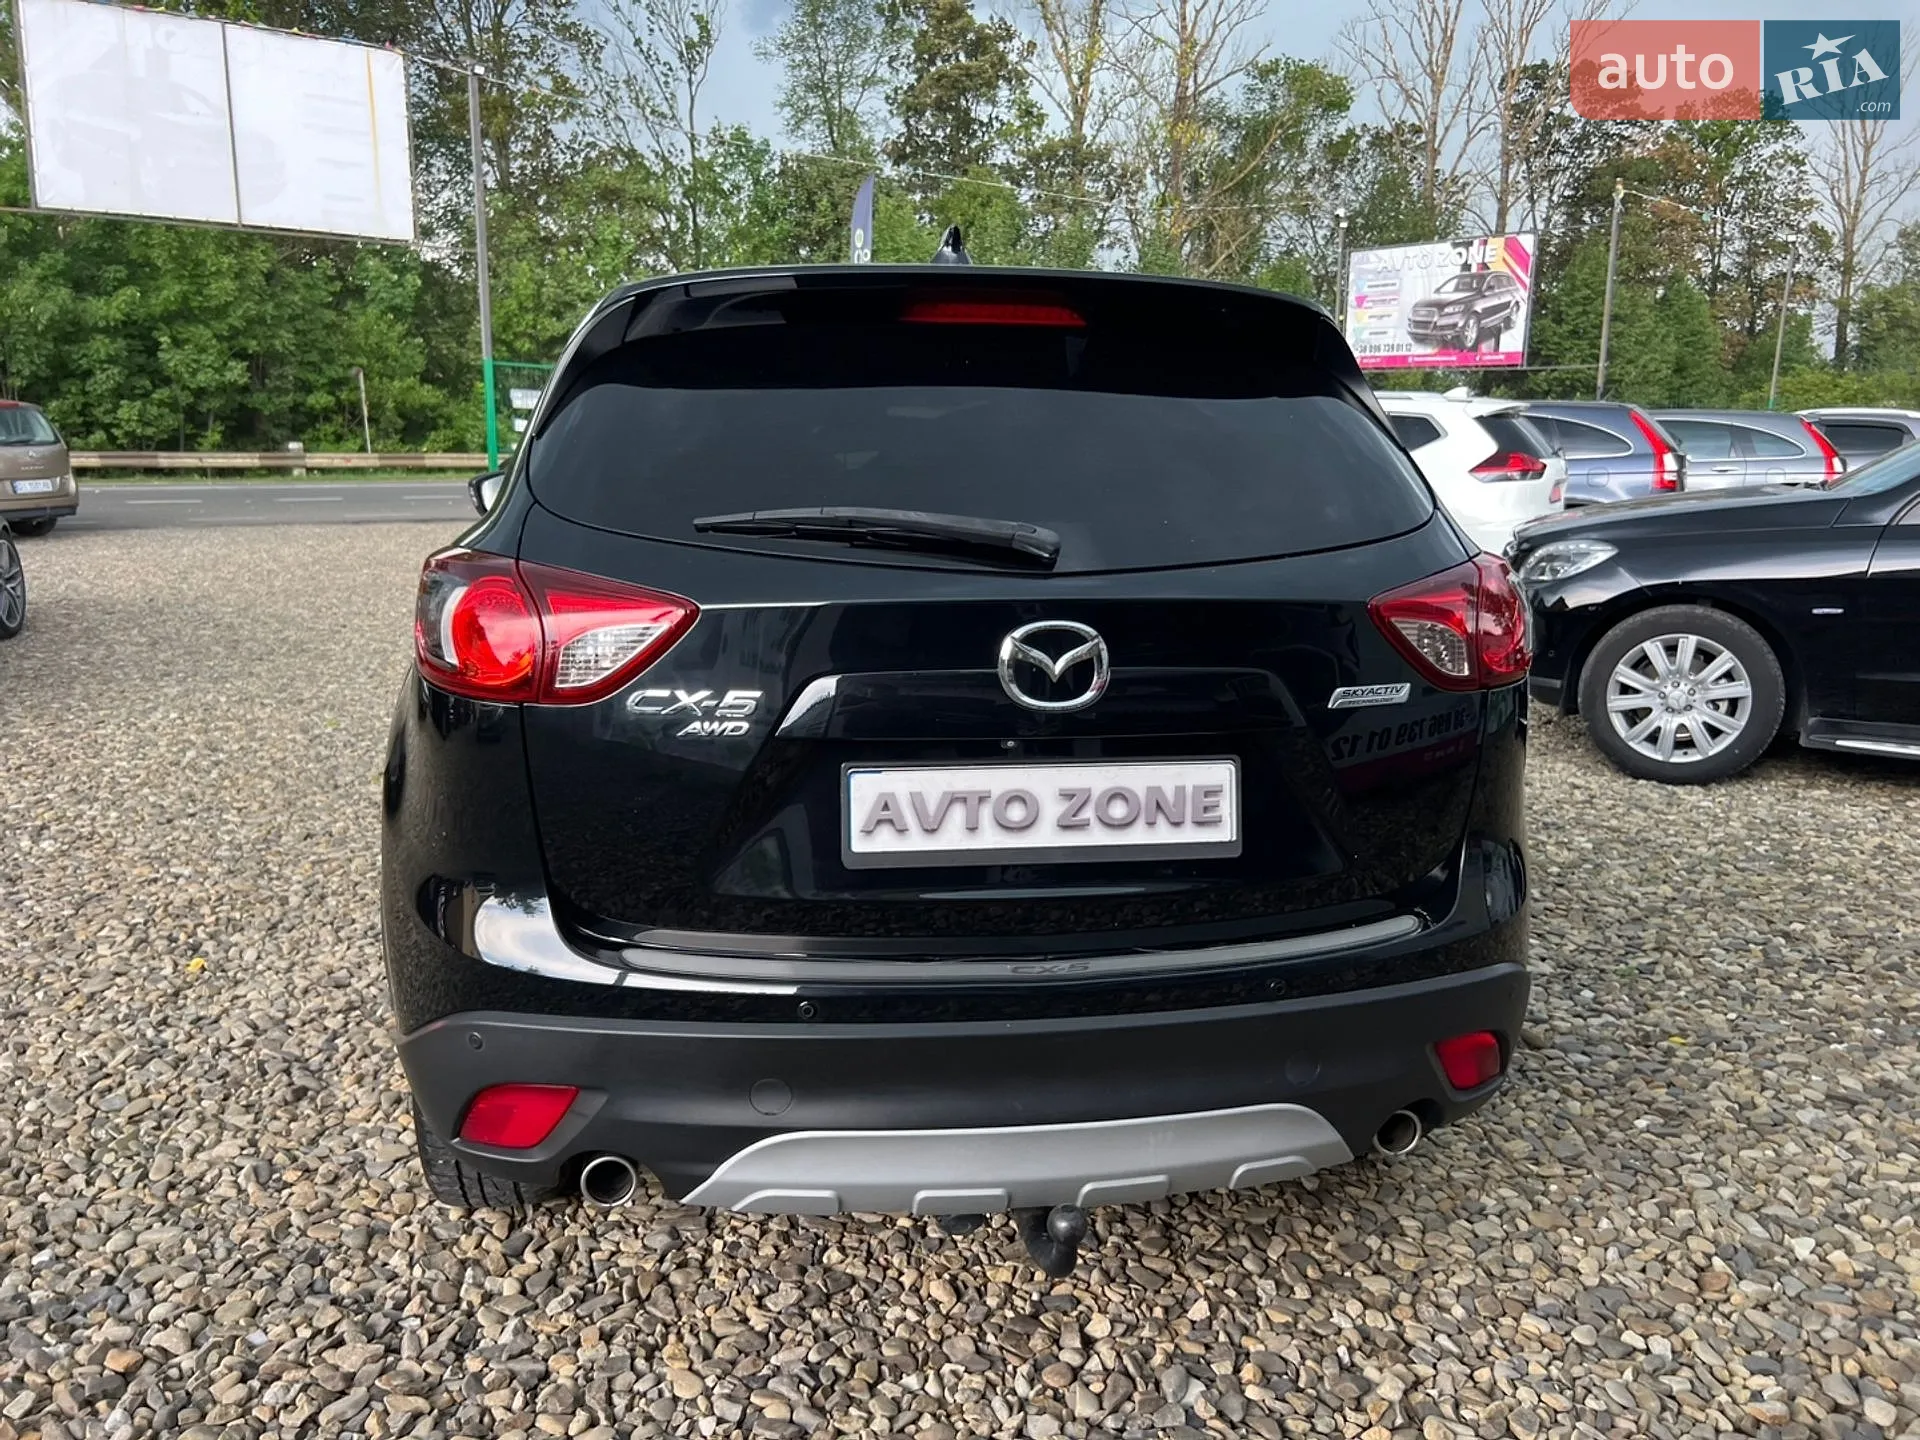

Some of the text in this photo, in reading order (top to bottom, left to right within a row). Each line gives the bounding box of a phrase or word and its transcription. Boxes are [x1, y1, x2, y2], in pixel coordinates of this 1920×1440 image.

[1436, 245, 1498, 267] ZONE
[1342, 685, 1404, 697] SKYACTIV
[626, 689, 763, 717] CX-5
[676, 720, 749, 736] AWD
[860, 784, 1223, 833] AVTO ZONE
[1010, 961, 1091, 976] CX-5
